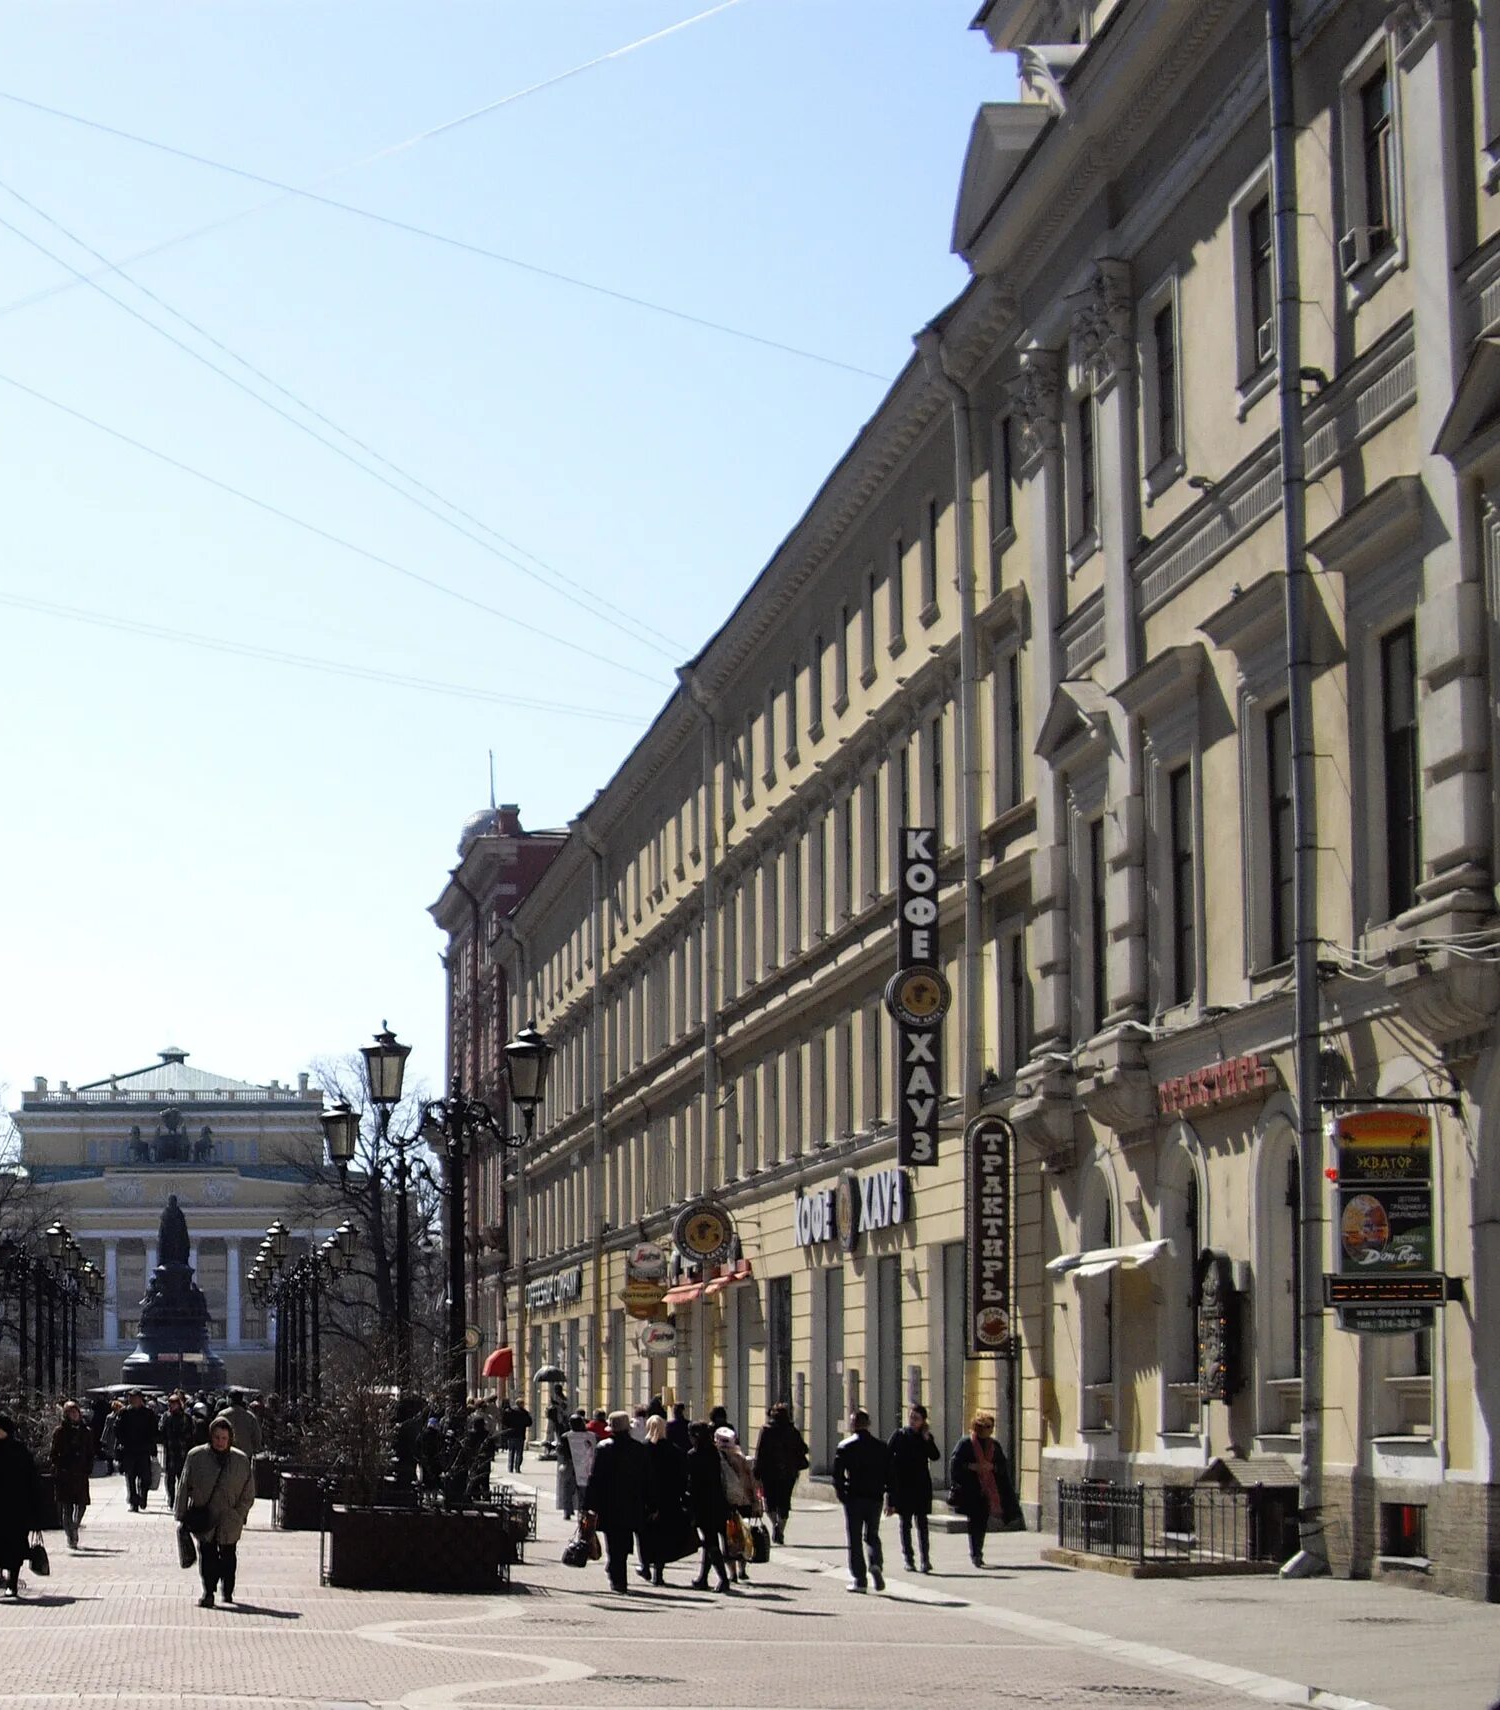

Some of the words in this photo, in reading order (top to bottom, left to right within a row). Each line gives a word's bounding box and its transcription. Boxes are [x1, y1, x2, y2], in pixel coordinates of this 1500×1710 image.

[903, 829, 937, 959] КОФЕ
[905, 1032, 936, 1161] ХАУЗ
[794, 1189, 833, 1248] КОФЕ
[858, 1168, 904, 1233] ХАУЗ
[1356, 1154, 1413, 1169] ЭКВАТОР
